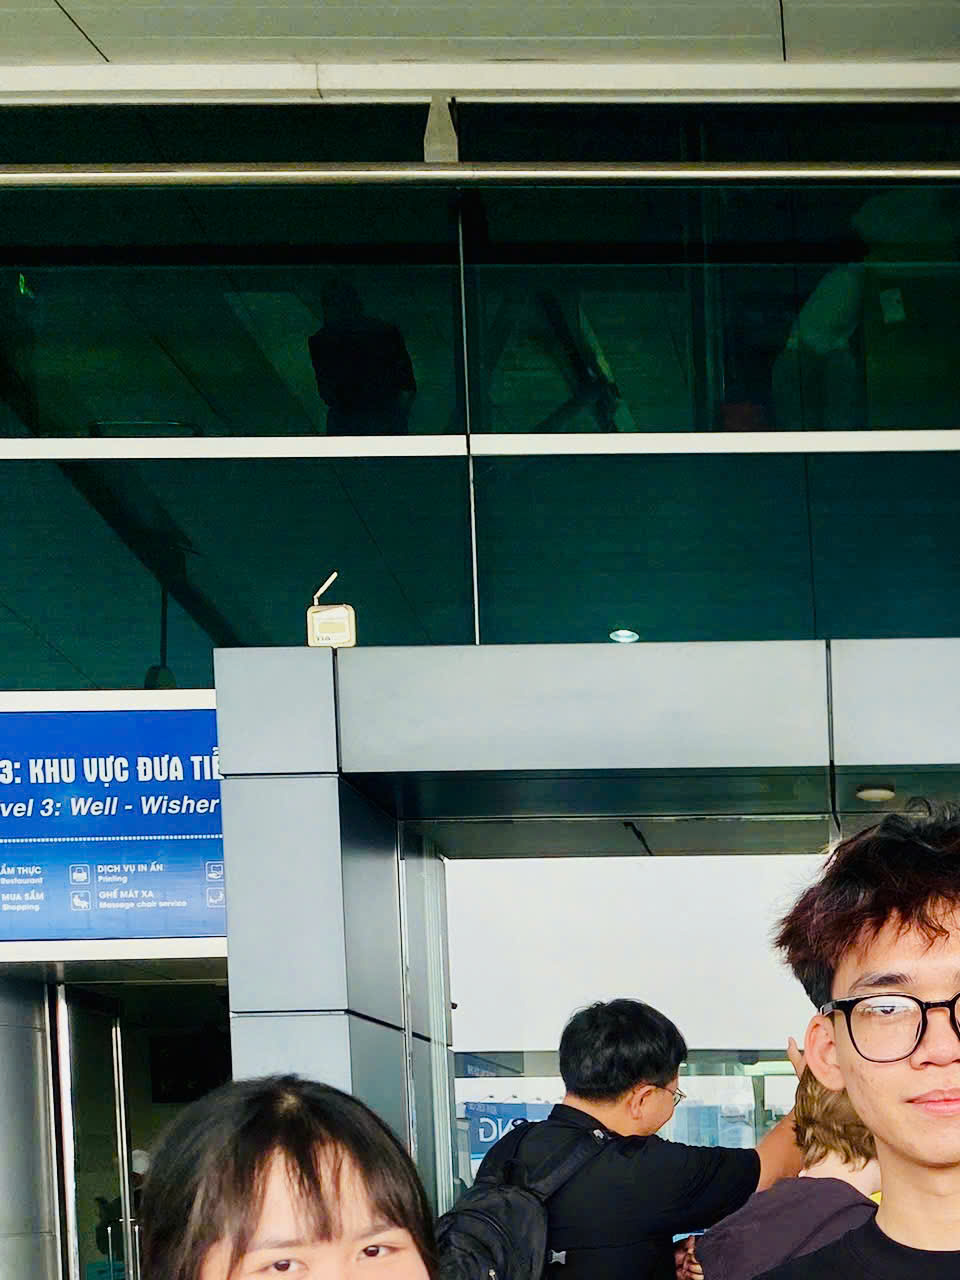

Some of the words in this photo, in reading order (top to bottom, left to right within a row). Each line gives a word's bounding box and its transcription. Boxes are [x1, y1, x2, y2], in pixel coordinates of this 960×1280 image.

[29, 758, 76, 783] KHU
[83, 755, 129, 787] VỰC
[137, 755, 184, 782] ĐƯA
[40, 799, 61, 816] 3:
[70, 797, 118, 817] Well
[140, 796, 220, 815] Wisher
[97, 864, 121, 874] DỊCH
[123, 864, 136, 874] VỤ
[138, 864, 148, 872] IN
